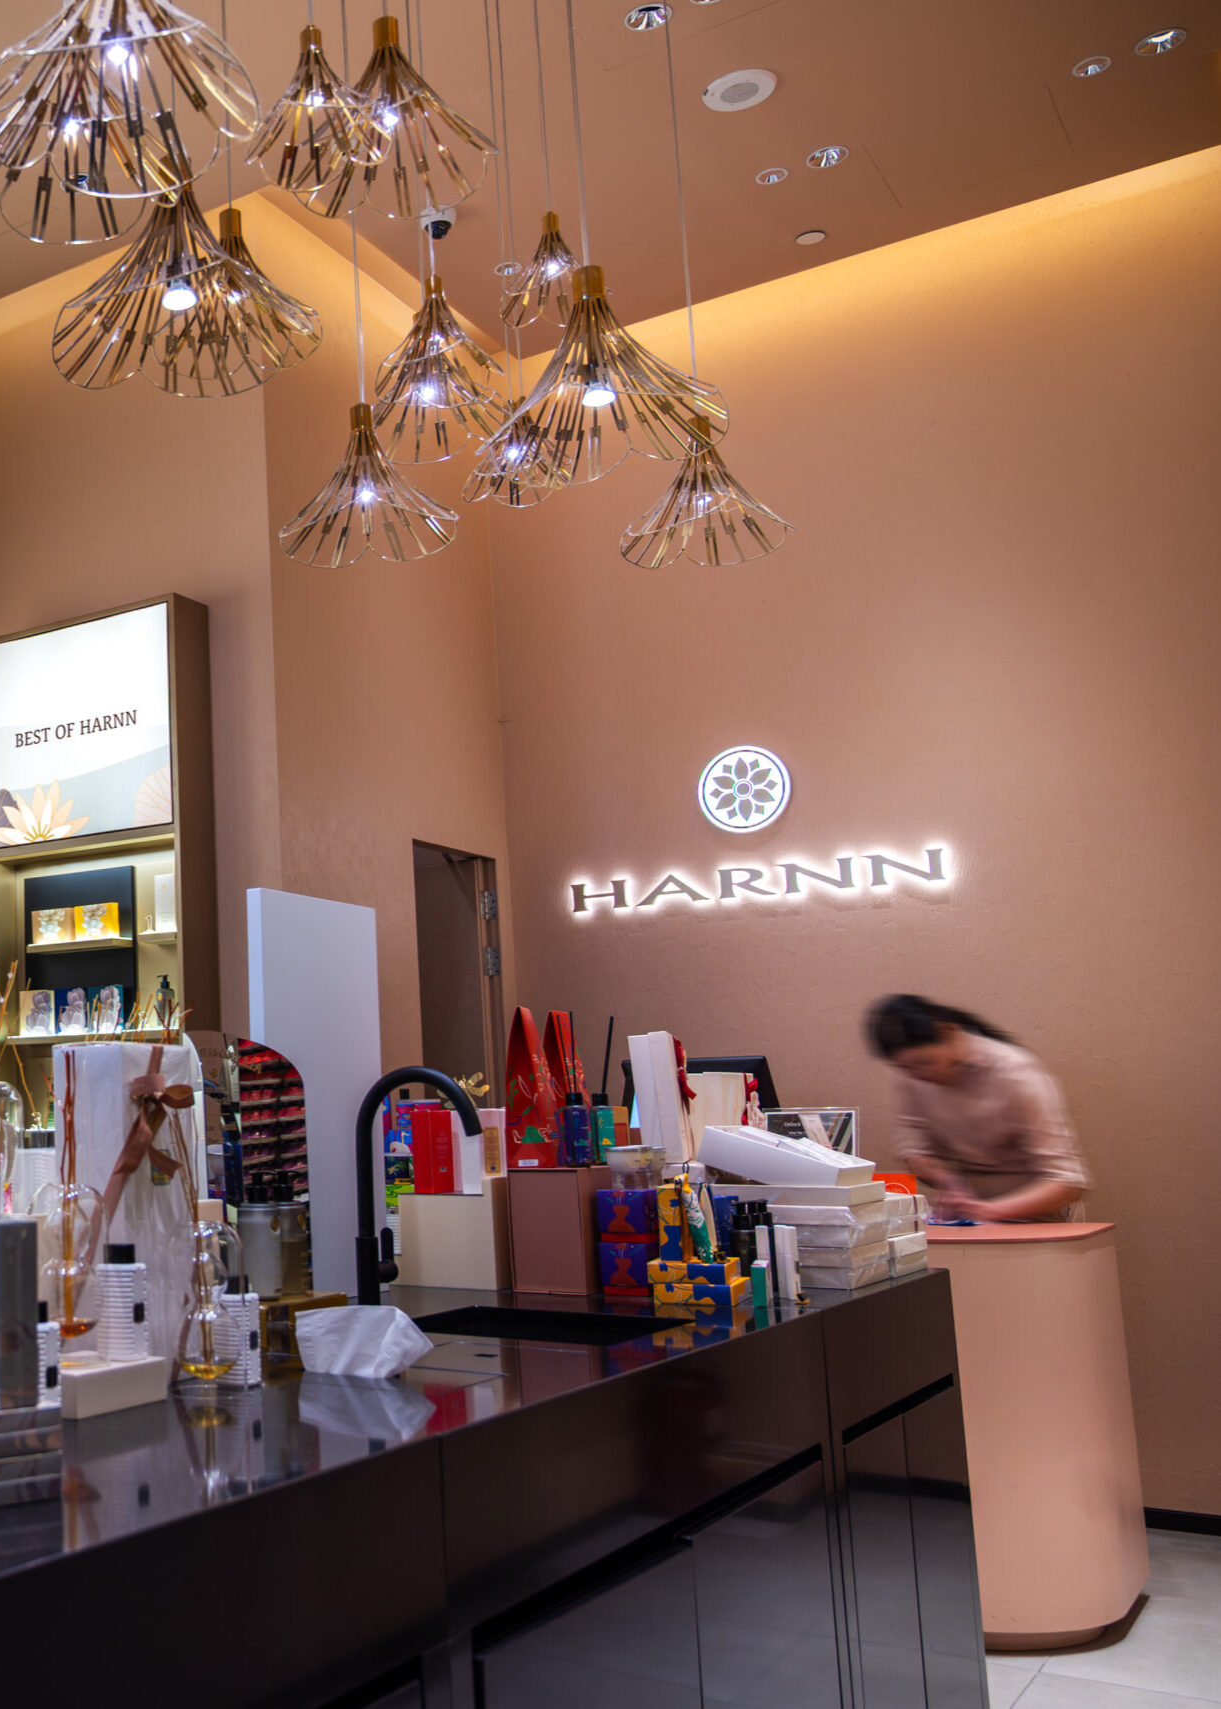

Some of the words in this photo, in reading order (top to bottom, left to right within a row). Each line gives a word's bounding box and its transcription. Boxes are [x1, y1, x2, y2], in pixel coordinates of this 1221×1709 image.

[14, 727, 51, 748] BEST
[55, 722, 75, 740] OF
[80, 709, 138, 736] HARNN
[570, 848, 947, 913] HARNN
